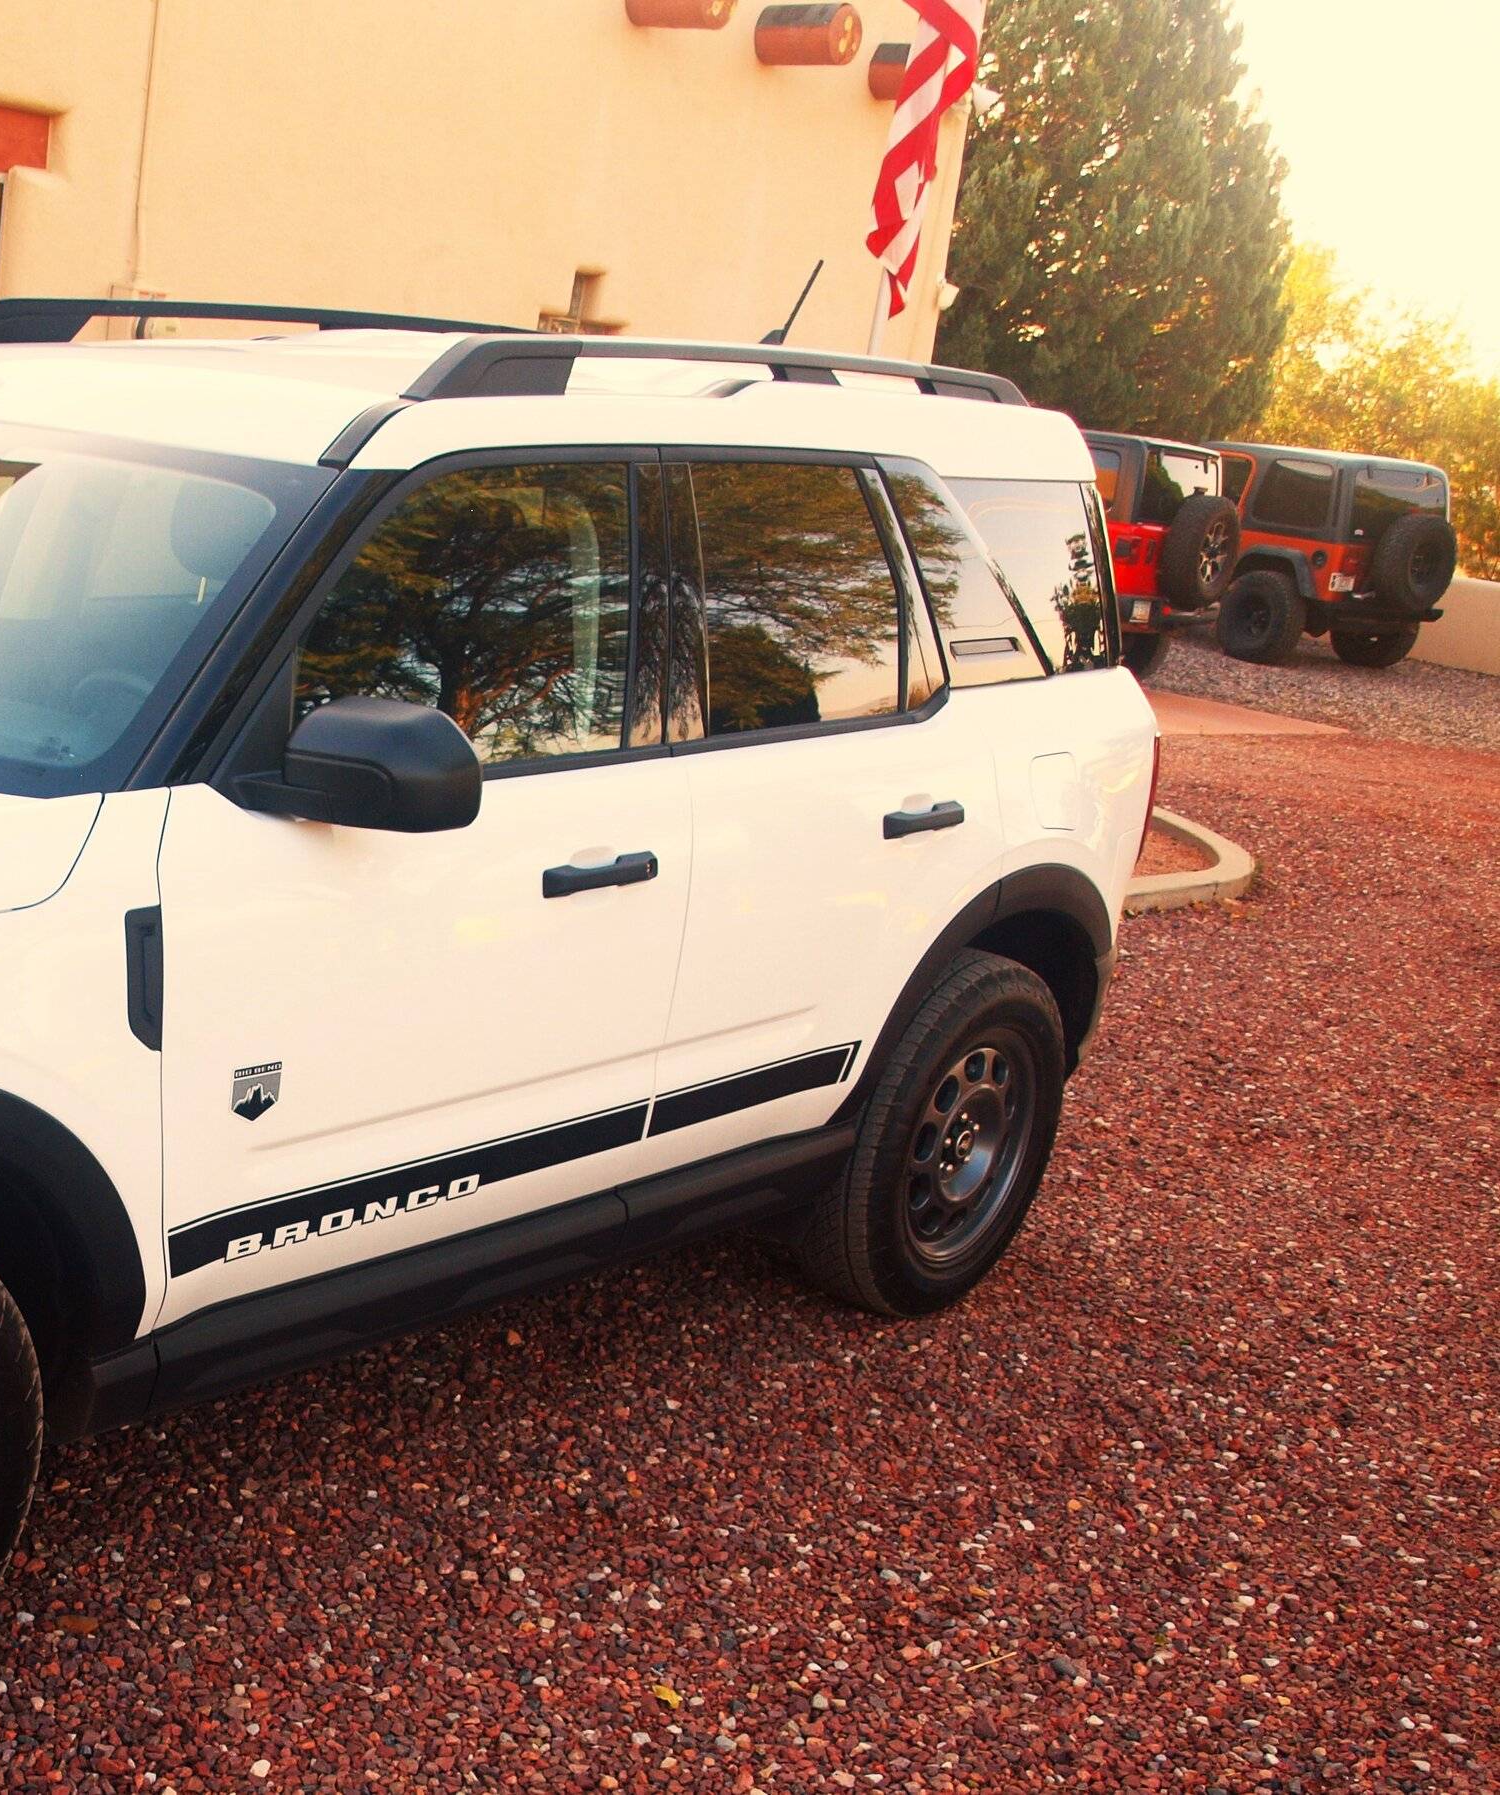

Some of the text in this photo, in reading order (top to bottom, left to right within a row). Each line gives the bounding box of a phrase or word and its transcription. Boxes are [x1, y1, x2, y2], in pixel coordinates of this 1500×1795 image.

[235, 1063, 282, 1078] BIG BEND
[224, 1173, 480, 1263] BRONCO
